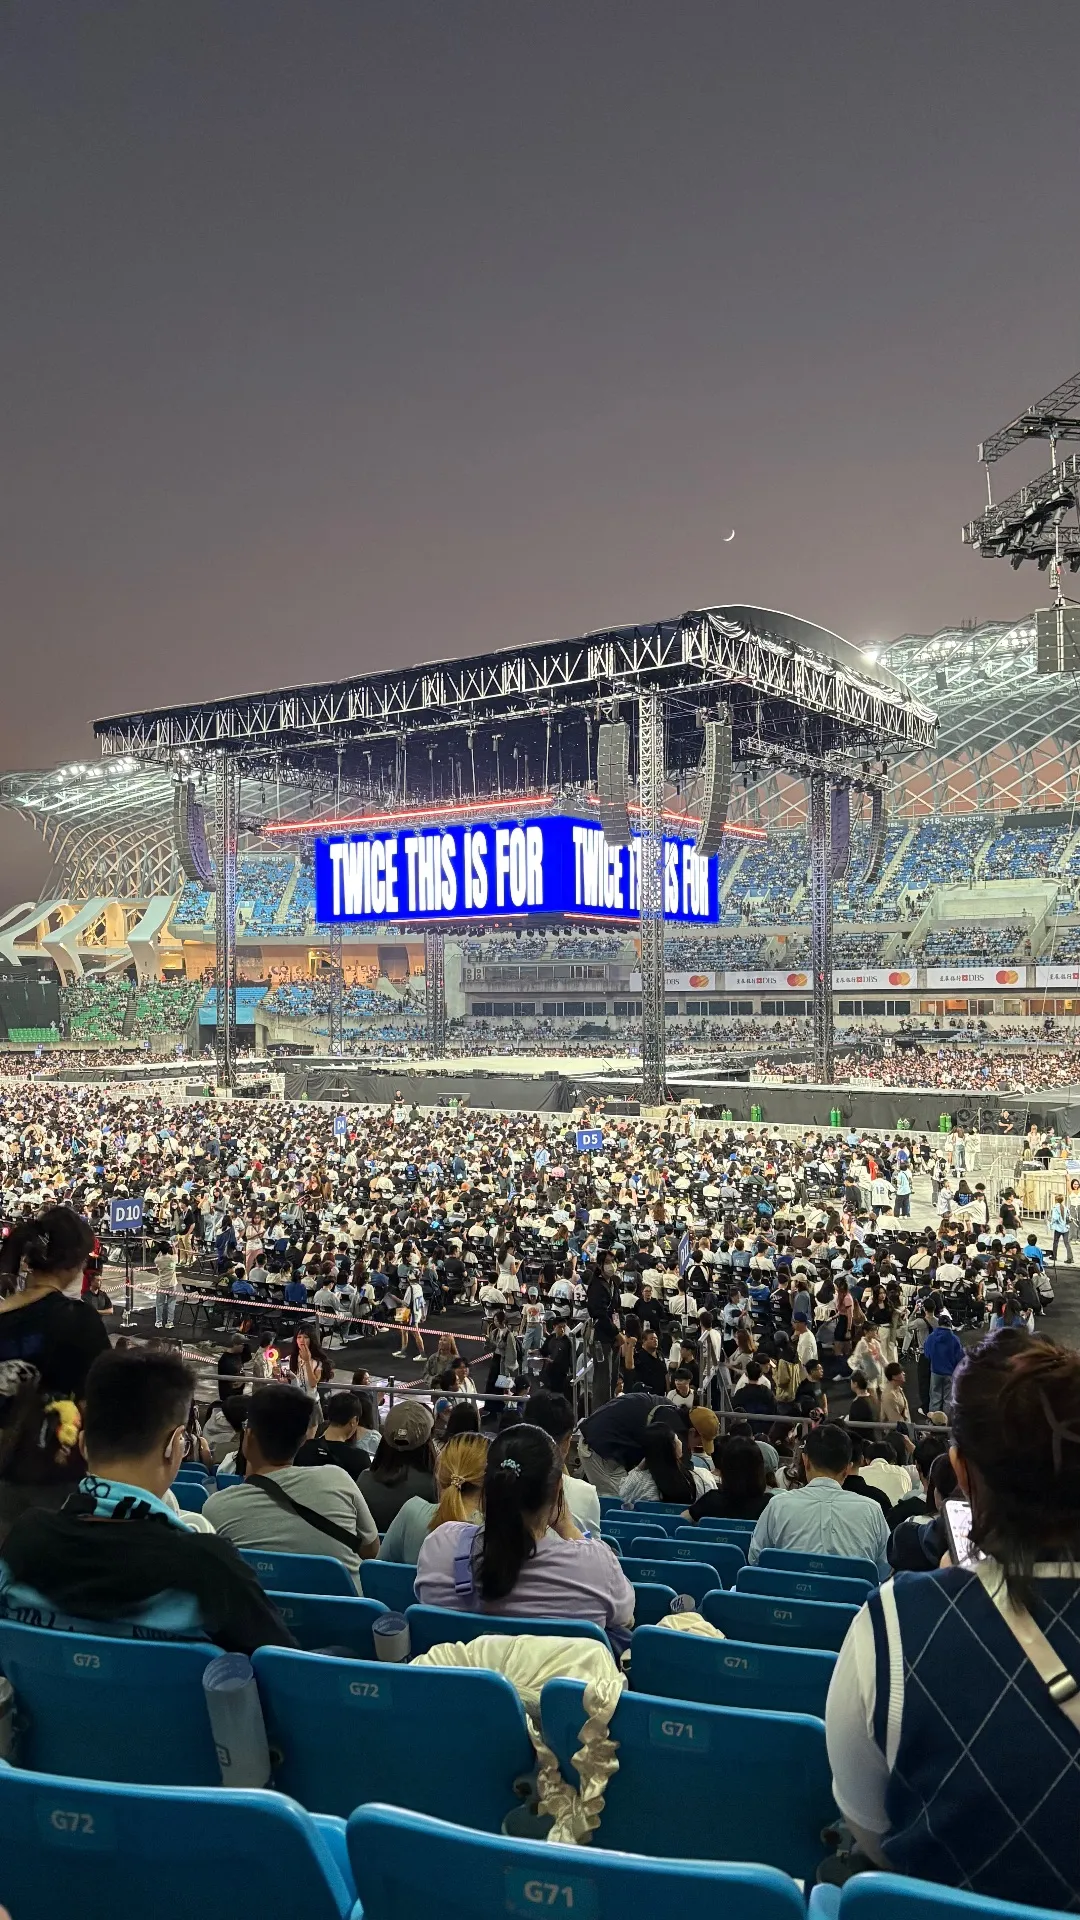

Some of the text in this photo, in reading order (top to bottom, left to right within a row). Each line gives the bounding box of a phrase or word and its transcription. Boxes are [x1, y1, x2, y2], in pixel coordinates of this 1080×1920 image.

[329, 825, 544, 915] TWICE THIS IS FOR
[573, 826, 624, 909] TWICE
[664, 841, 679, 914] IS
[968, 974, 985, 982] DBS
[337, 1120, 344, 1130] D4
[582, 1134, 598, 1145] D5
[875, 1186, 885, 1195] 12
[115, 1205, 141, 1222] D10
[256, 1562, 274, 1571] G74
[640, 1569, 656, 1577] G72
[796, 1583, 812, 1592] G71
[773, 1609, 793, 1620] G71
[73, 1652, 101, 1669] G73
[724, 1656, 748, 1670] G71
[349, 1682, 380, 1698] G72
[661, 1720, 693, 1739] G71
[50, 1809, 95, 1834] G72
[523, 1880, 574, 1908] G71
